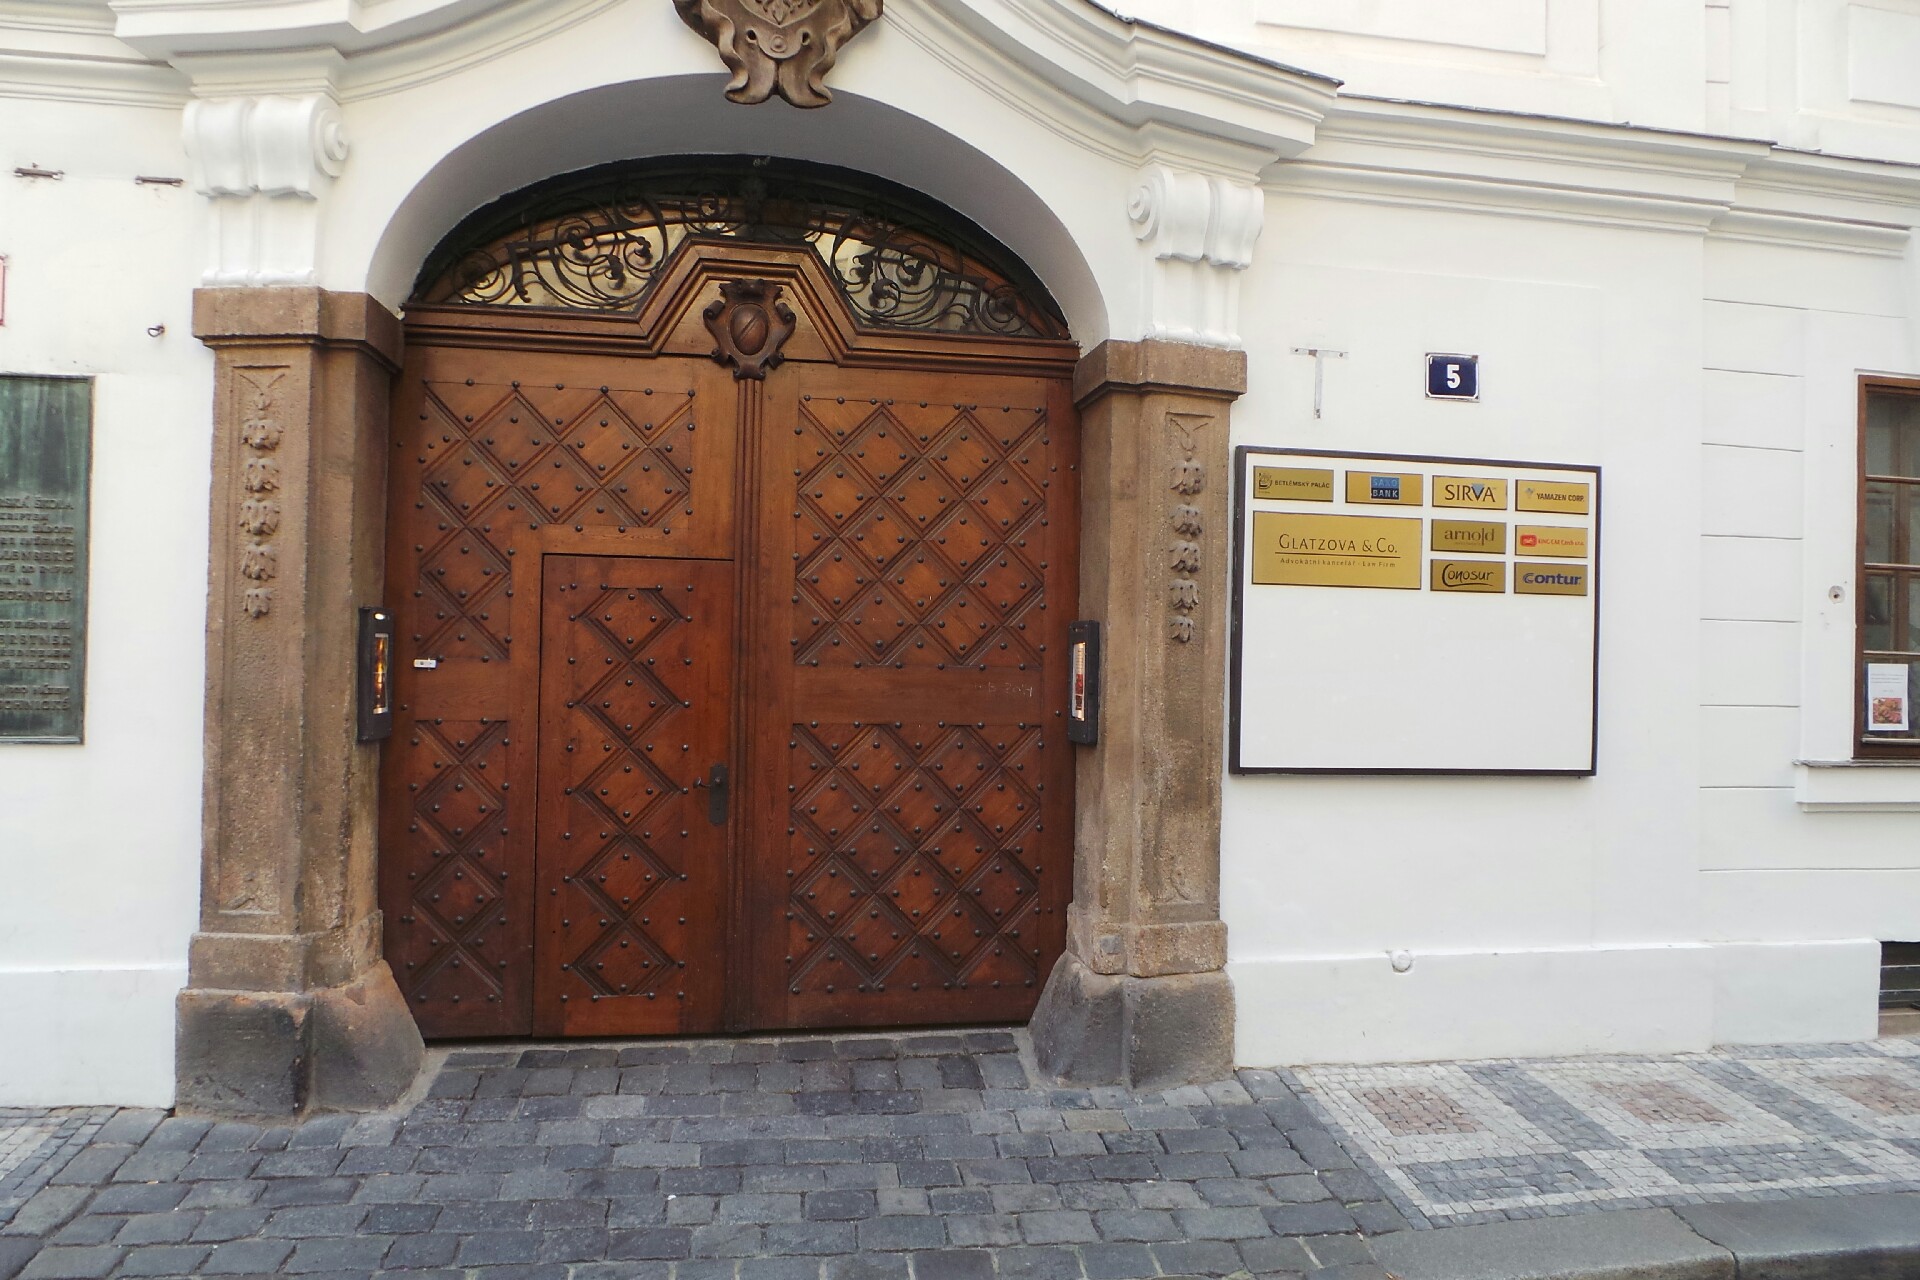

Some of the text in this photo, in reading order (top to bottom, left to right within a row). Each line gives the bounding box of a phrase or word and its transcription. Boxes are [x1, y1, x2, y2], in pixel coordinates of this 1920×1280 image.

[1446, 363, 1461, 389] 5
[1310, 480, 1330, 489] PALÁC
[1373, 478, 1398, 488] SAXO
[1372, 488, 1398, 498] BANK
[1444, 483, 1496, 503] SIRVA
[1536, 492, 1567, 501] YAMAZEN
[1362, 538, 1372, 552] &
[1376, 537, 1398, 554] Co.
[1362, 560, 1376, 568] Law
[1378, 560, 1396, 568] Firm
[1441, 563, 1495, 588] Conosur
